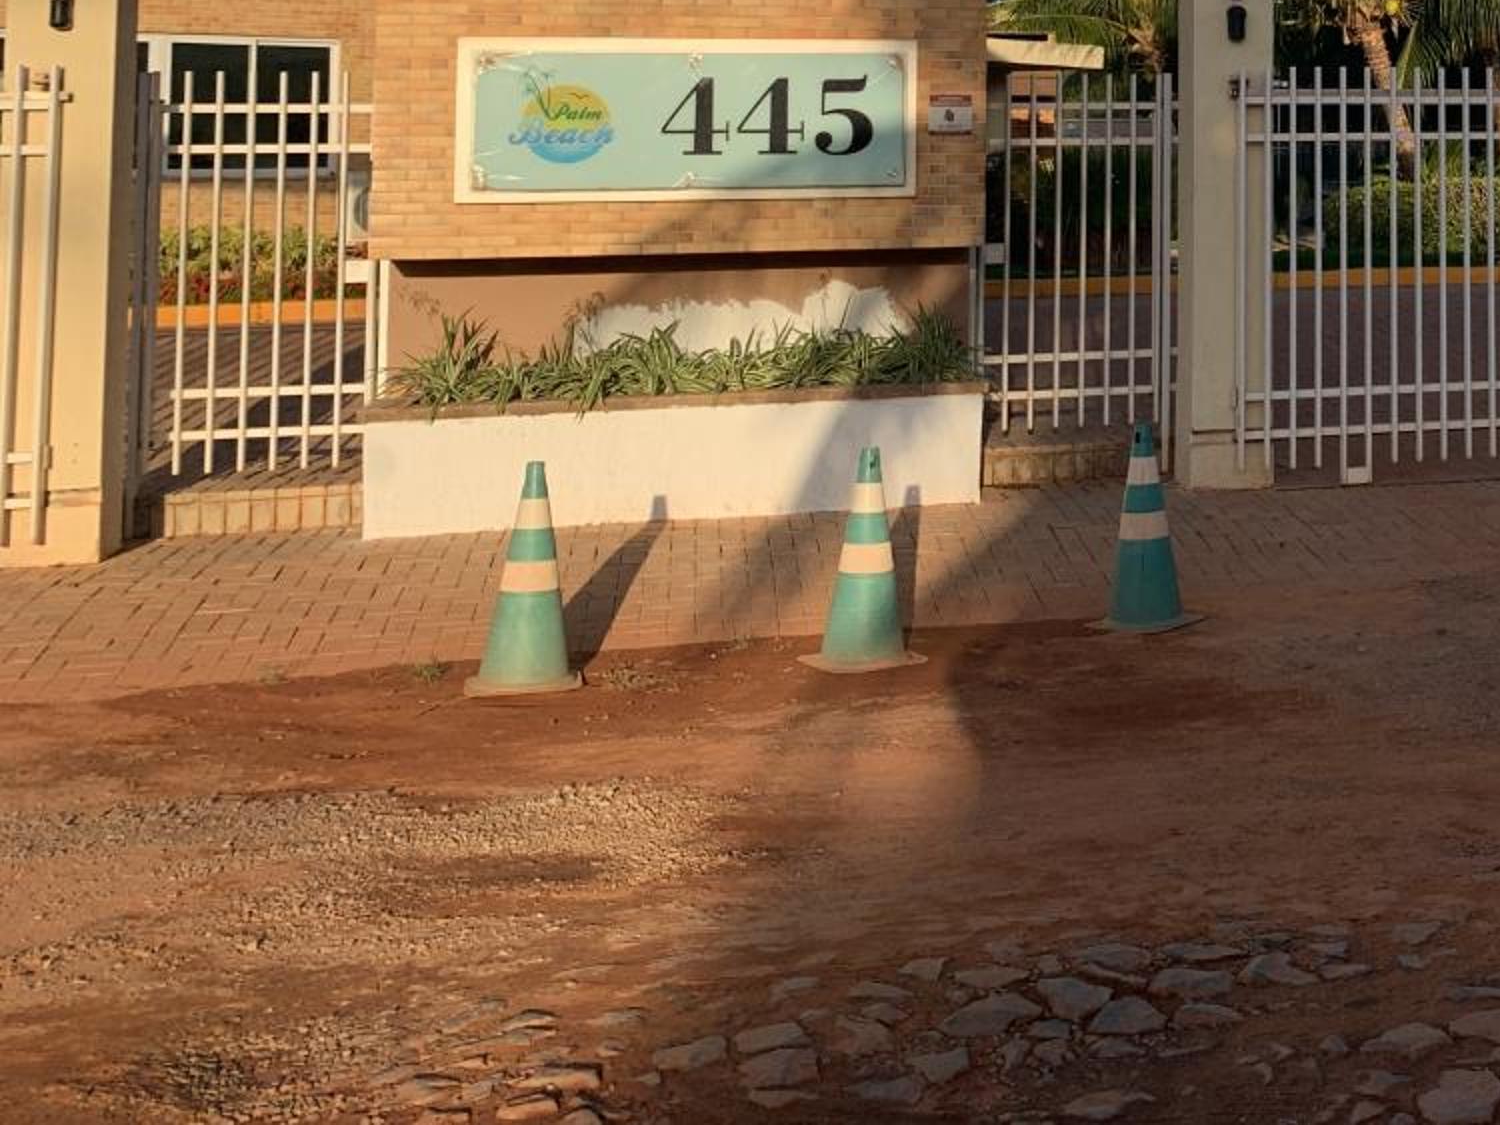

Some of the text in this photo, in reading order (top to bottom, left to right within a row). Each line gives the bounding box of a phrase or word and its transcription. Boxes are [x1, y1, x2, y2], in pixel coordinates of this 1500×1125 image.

[554, 103, 603, 121] Palm
[661, 74, 874, 156] 445
[509, 121, 614, 145] Beach
